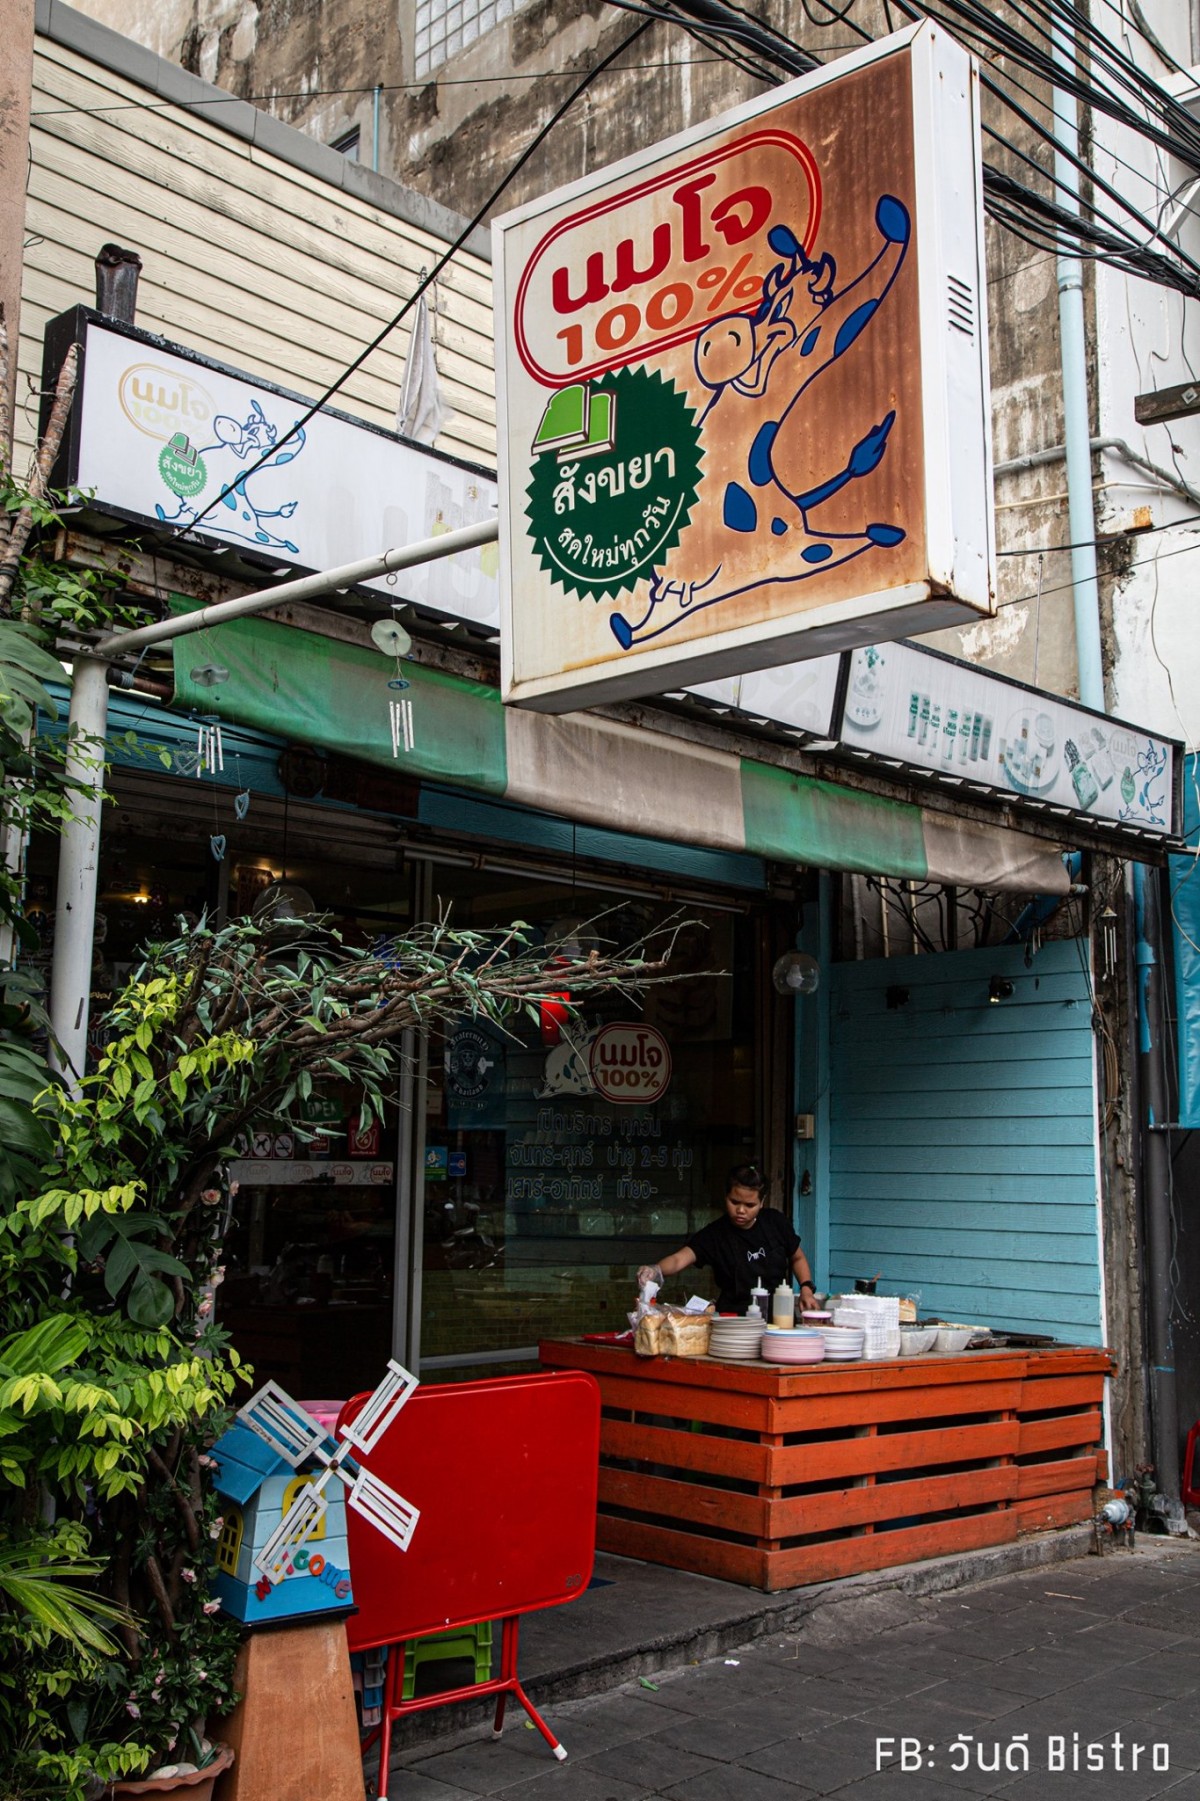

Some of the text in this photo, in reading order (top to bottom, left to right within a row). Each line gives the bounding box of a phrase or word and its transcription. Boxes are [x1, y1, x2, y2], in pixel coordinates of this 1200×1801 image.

[552, 173, 772, 313] นมโจ
[557, 252, 764, 365] 100%
[132, 378, 209, 421] นมโจ
[553, 446, 676, 515] สังขยา
[558, 494, 671, 569] สดใหม่ทุกวัน
[600, 1034, 662, 1068] นมโจ
[600, 1069, 660, 1089] 100%
[536, 1107, 661, 1143] เปิดบริการ ทุกวัน
[640, 1145, 669, 1167] 2-5
